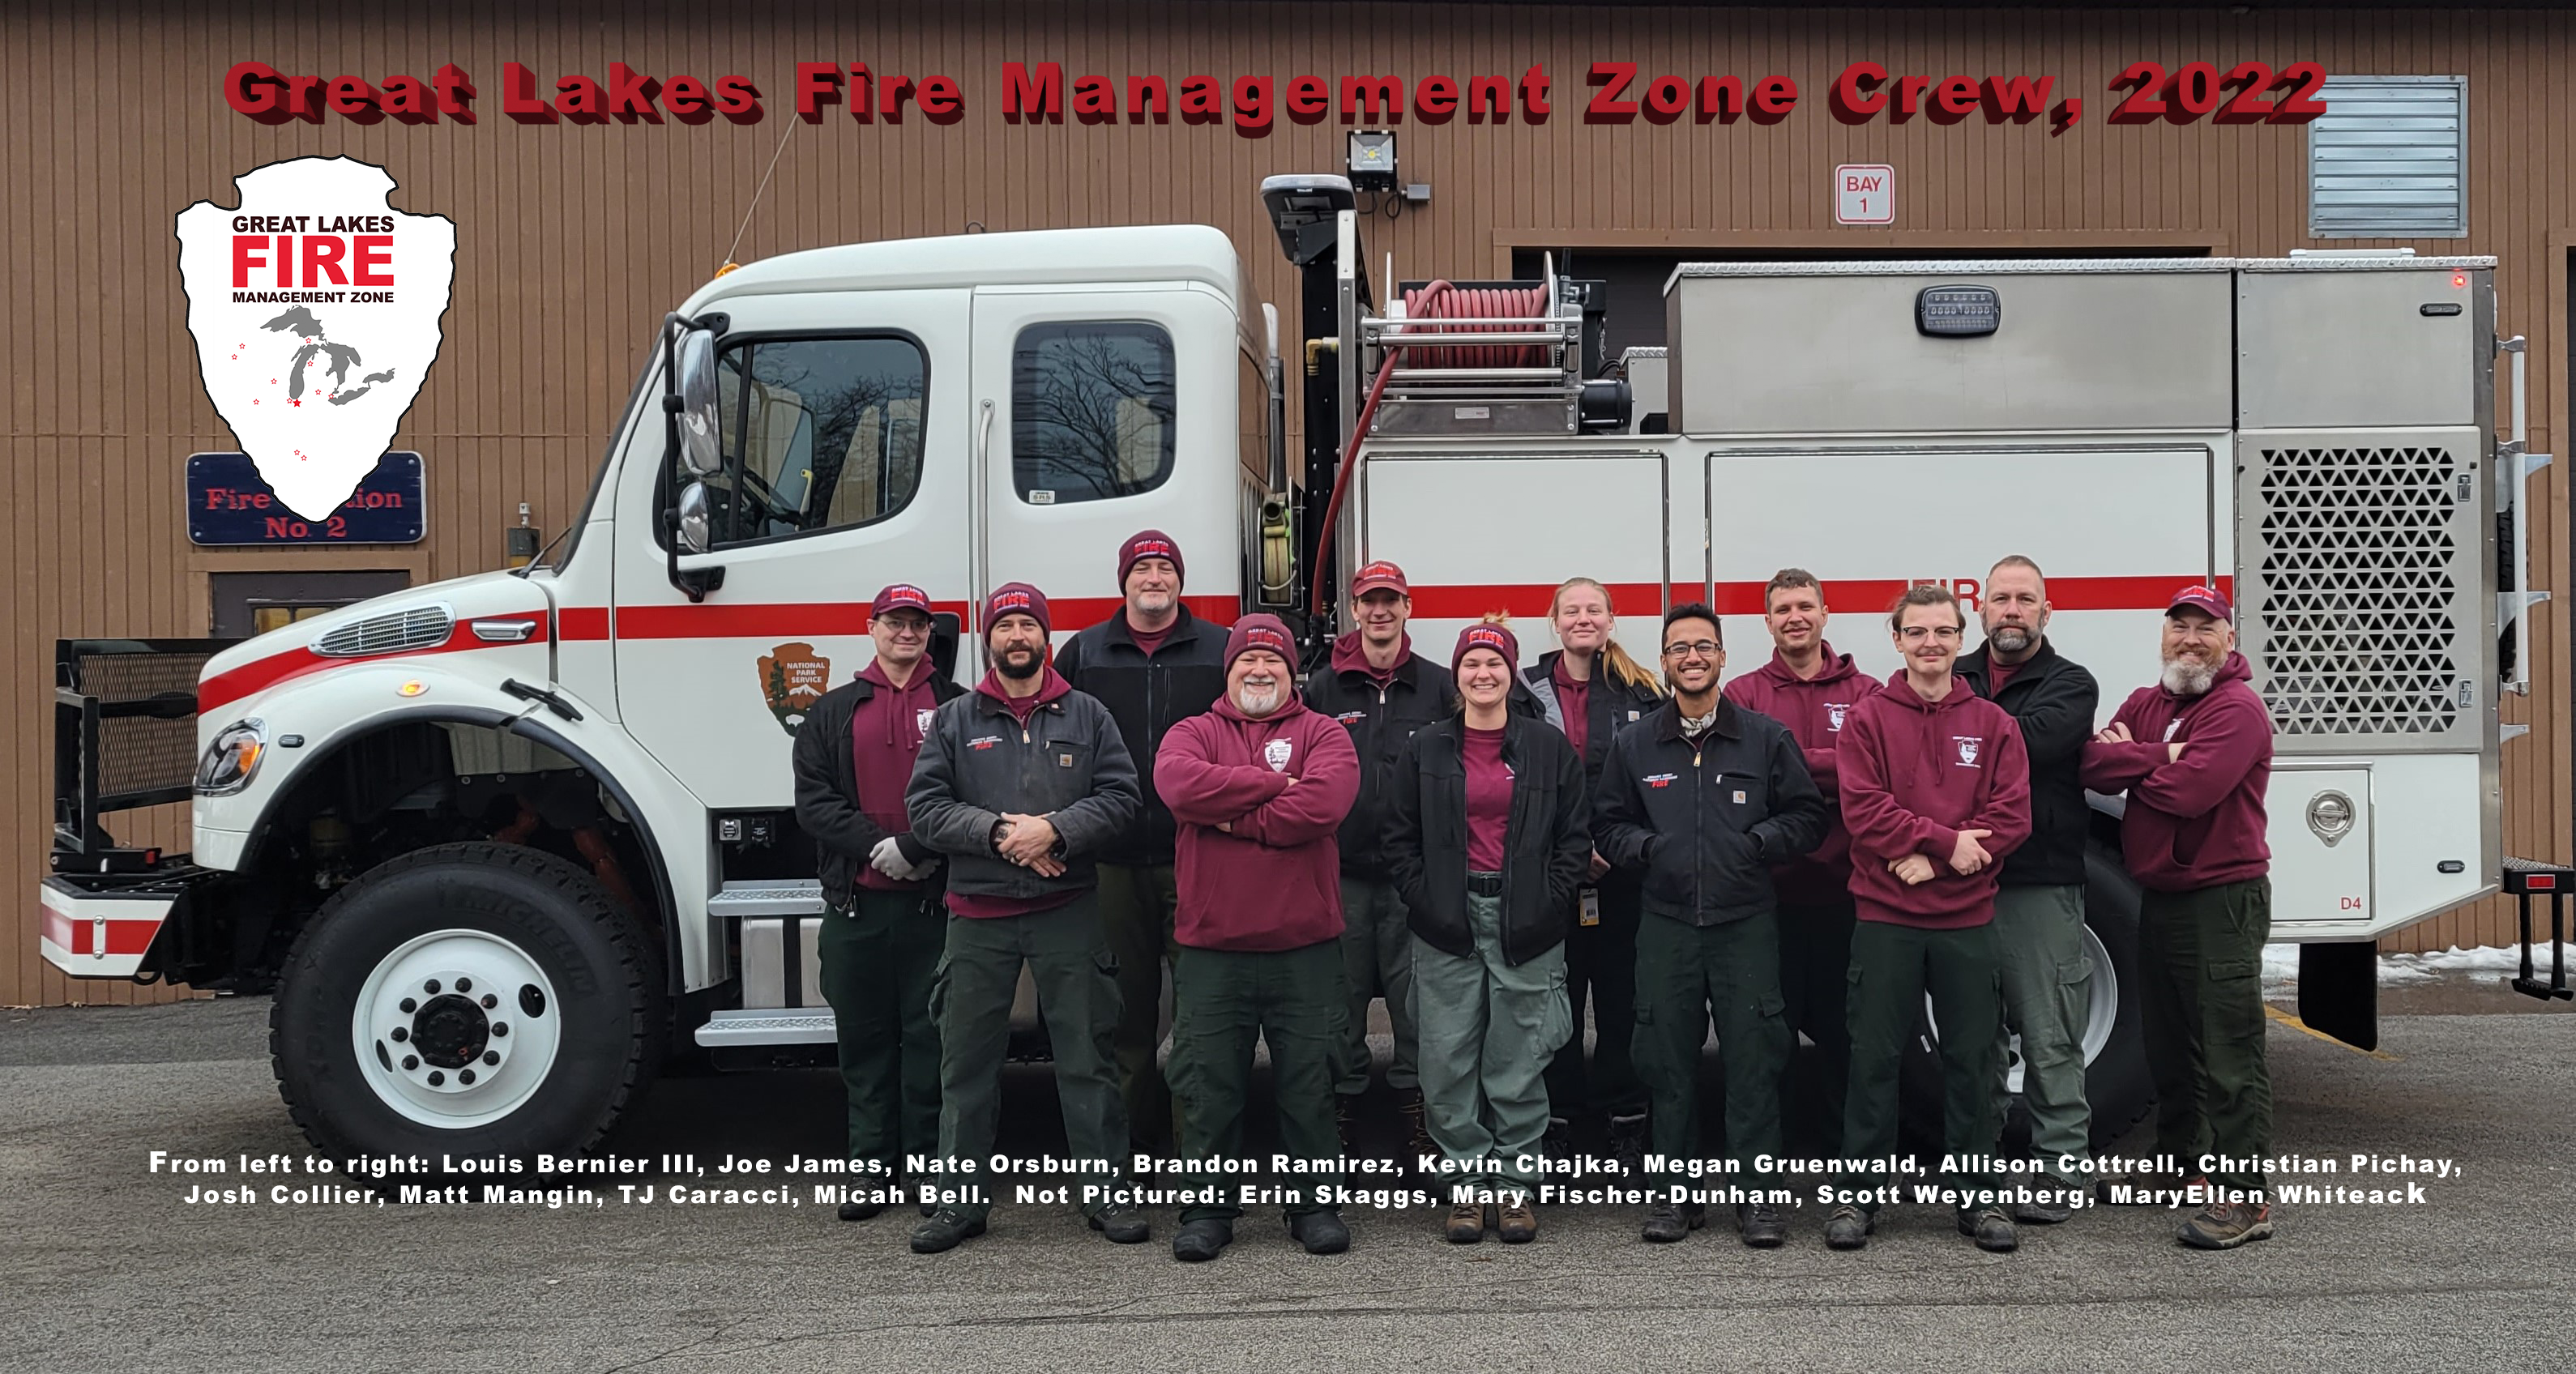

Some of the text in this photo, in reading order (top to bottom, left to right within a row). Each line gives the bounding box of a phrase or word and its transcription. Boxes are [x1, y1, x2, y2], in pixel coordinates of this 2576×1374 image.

[1846, 176, 1882, 192] BAY
[1859, 197, 1867, 213] 1
[205, 488, 271, 510] Fire
[327, 515, 347, 538] 2
[993, 595, 1030, 611] FIRE
[1469, 631, 1505, 647] FIRE
[791, 676, 822, 684] SERVICE
[2340, 897, 2361, 910] D4
